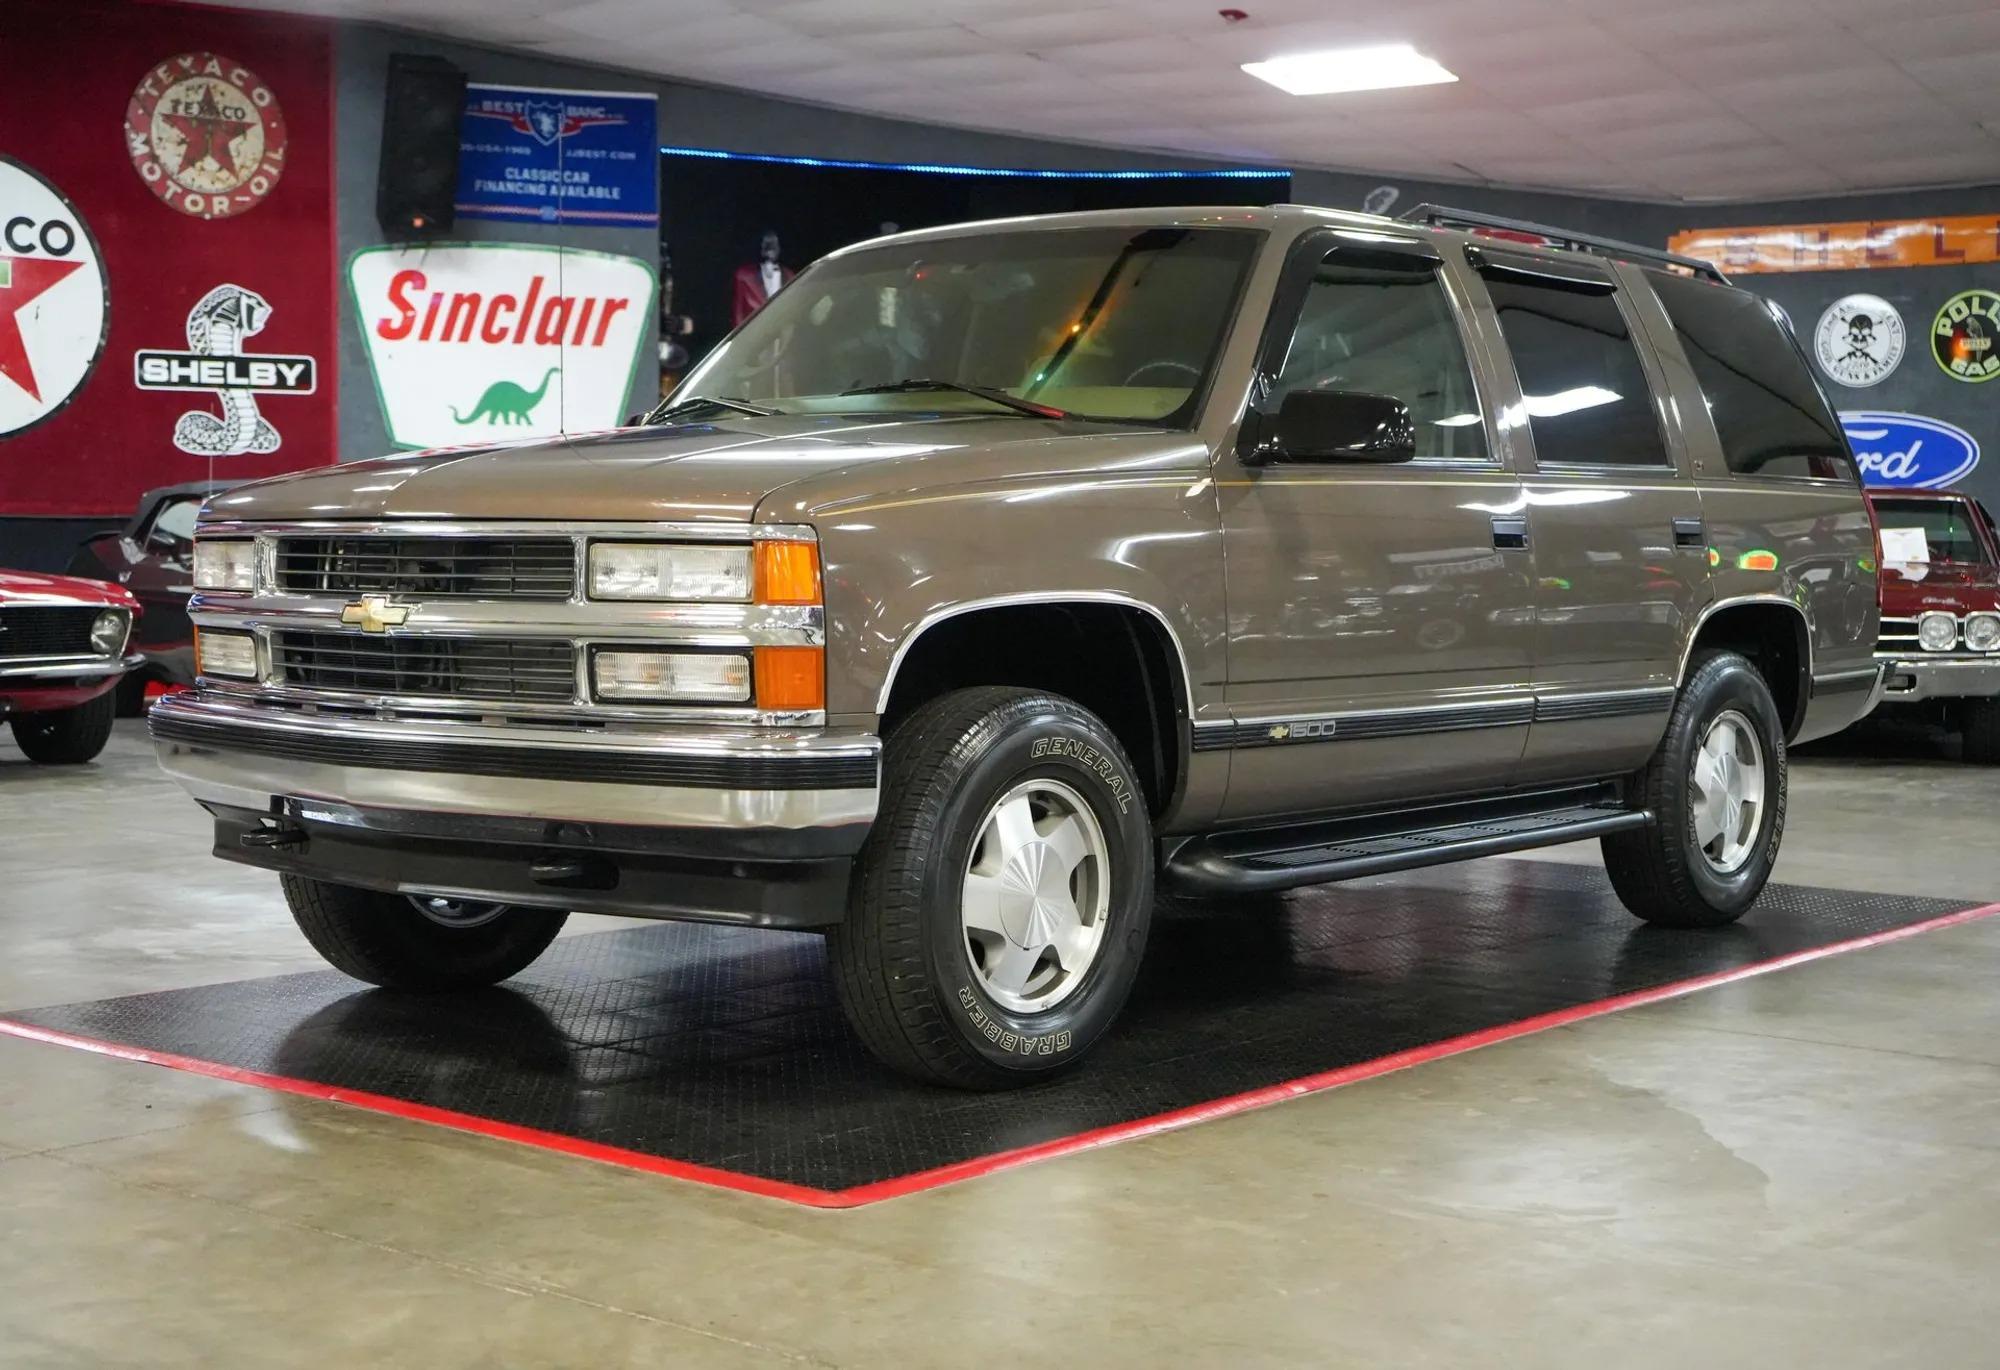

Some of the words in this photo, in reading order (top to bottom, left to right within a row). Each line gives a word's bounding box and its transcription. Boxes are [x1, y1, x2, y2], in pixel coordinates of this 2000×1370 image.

[143, 56, 271, 107] TEXACO
[481, 101, 524, 113] BEST
[474, 179, 546, 197] FINANCING
[549, 184, 621, 200] AVAILABLE
[505, 167, 560, 182] CLASSIC
[563, 170, 590, 184] CAR
[4, 215, 75, 256] CO
[376, 269, 629, 348] Sinclair
[1936, 295, 2000, 338] POLL
[142, 358, 306, 387] SHELBY
[1031, 737, 1128, 815] GENERAL
[959, 985, 1072, 1056] GRABBER
